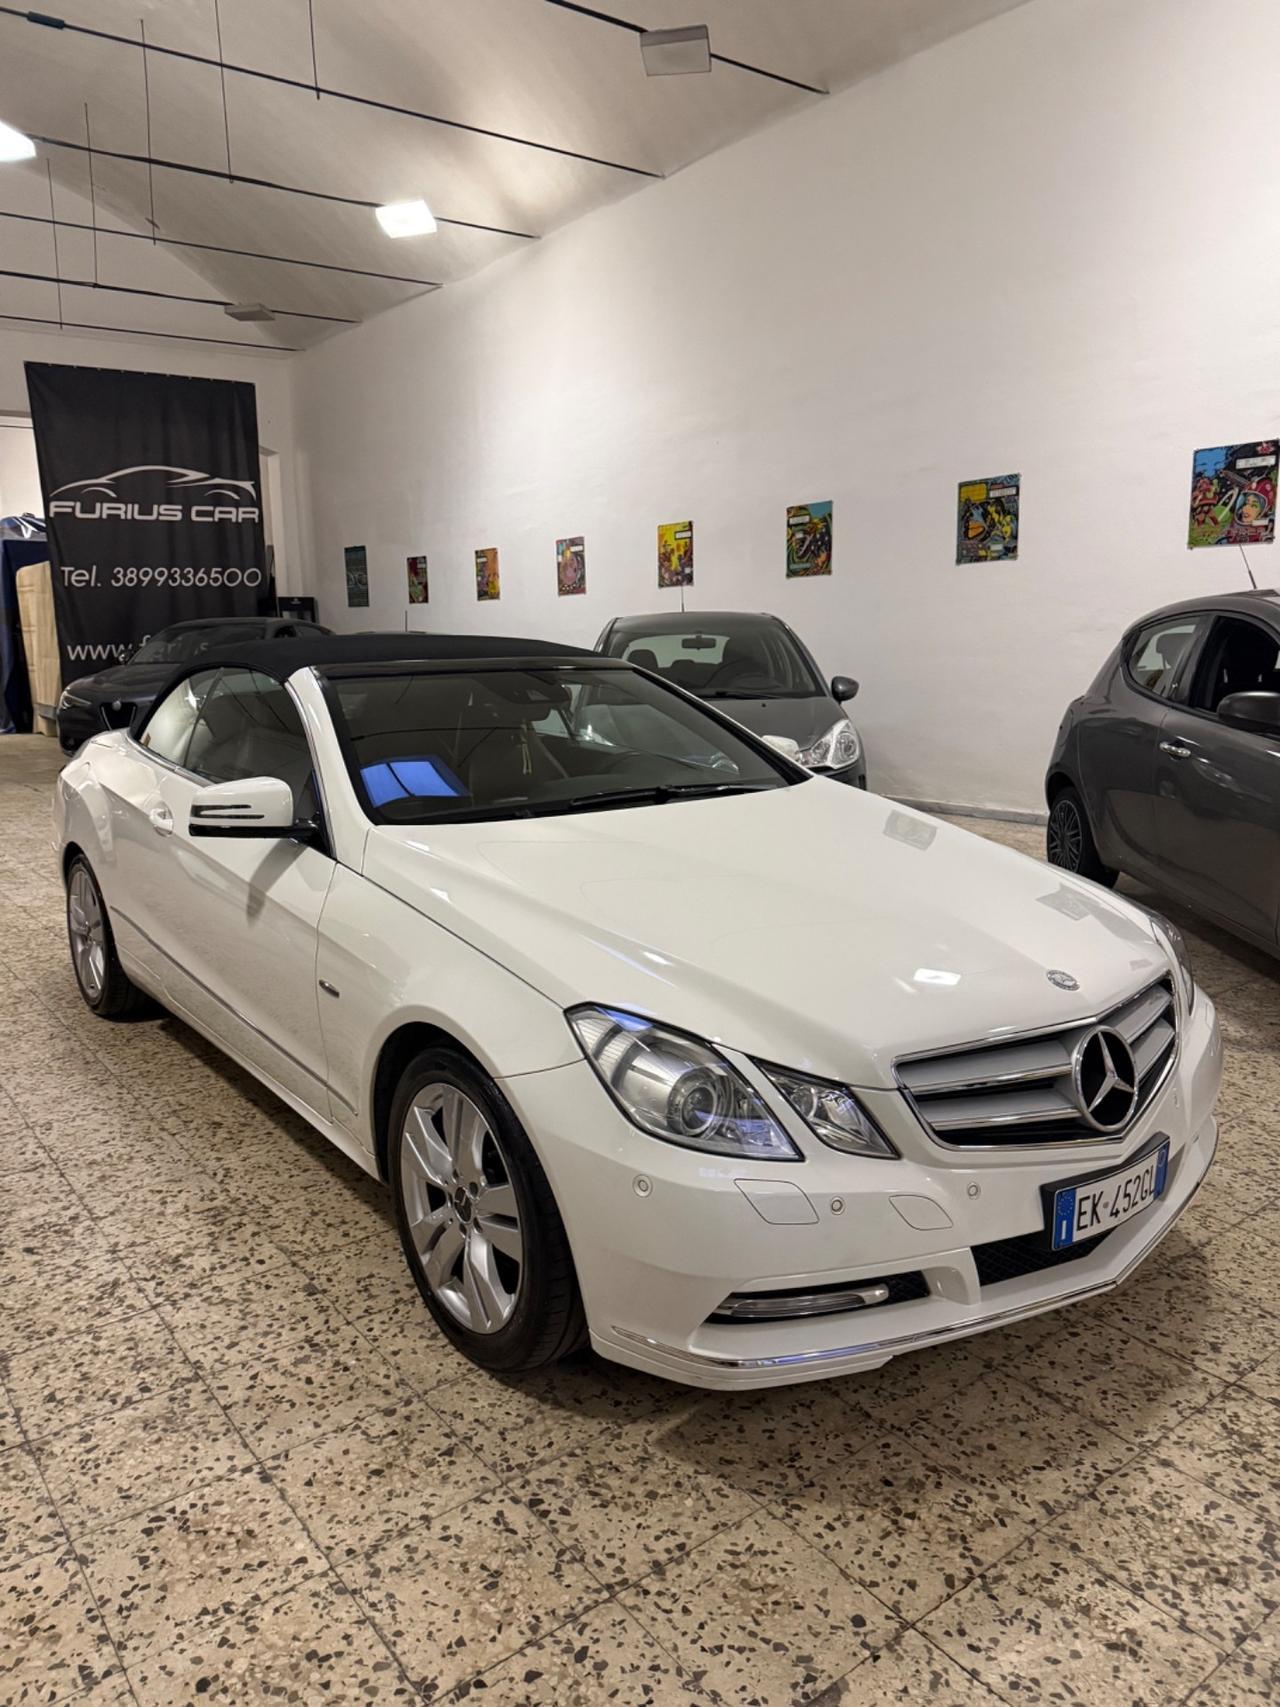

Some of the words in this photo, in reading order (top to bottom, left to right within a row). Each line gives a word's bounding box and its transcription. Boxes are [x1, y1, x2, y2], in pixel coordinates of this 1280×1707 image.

[49, 501, 182, 521] FURIUS
[191, 504, 259, 523] CAR
[60, 565, 102, 588] Tel.
[111, 566, 262, 588] 3899336500
